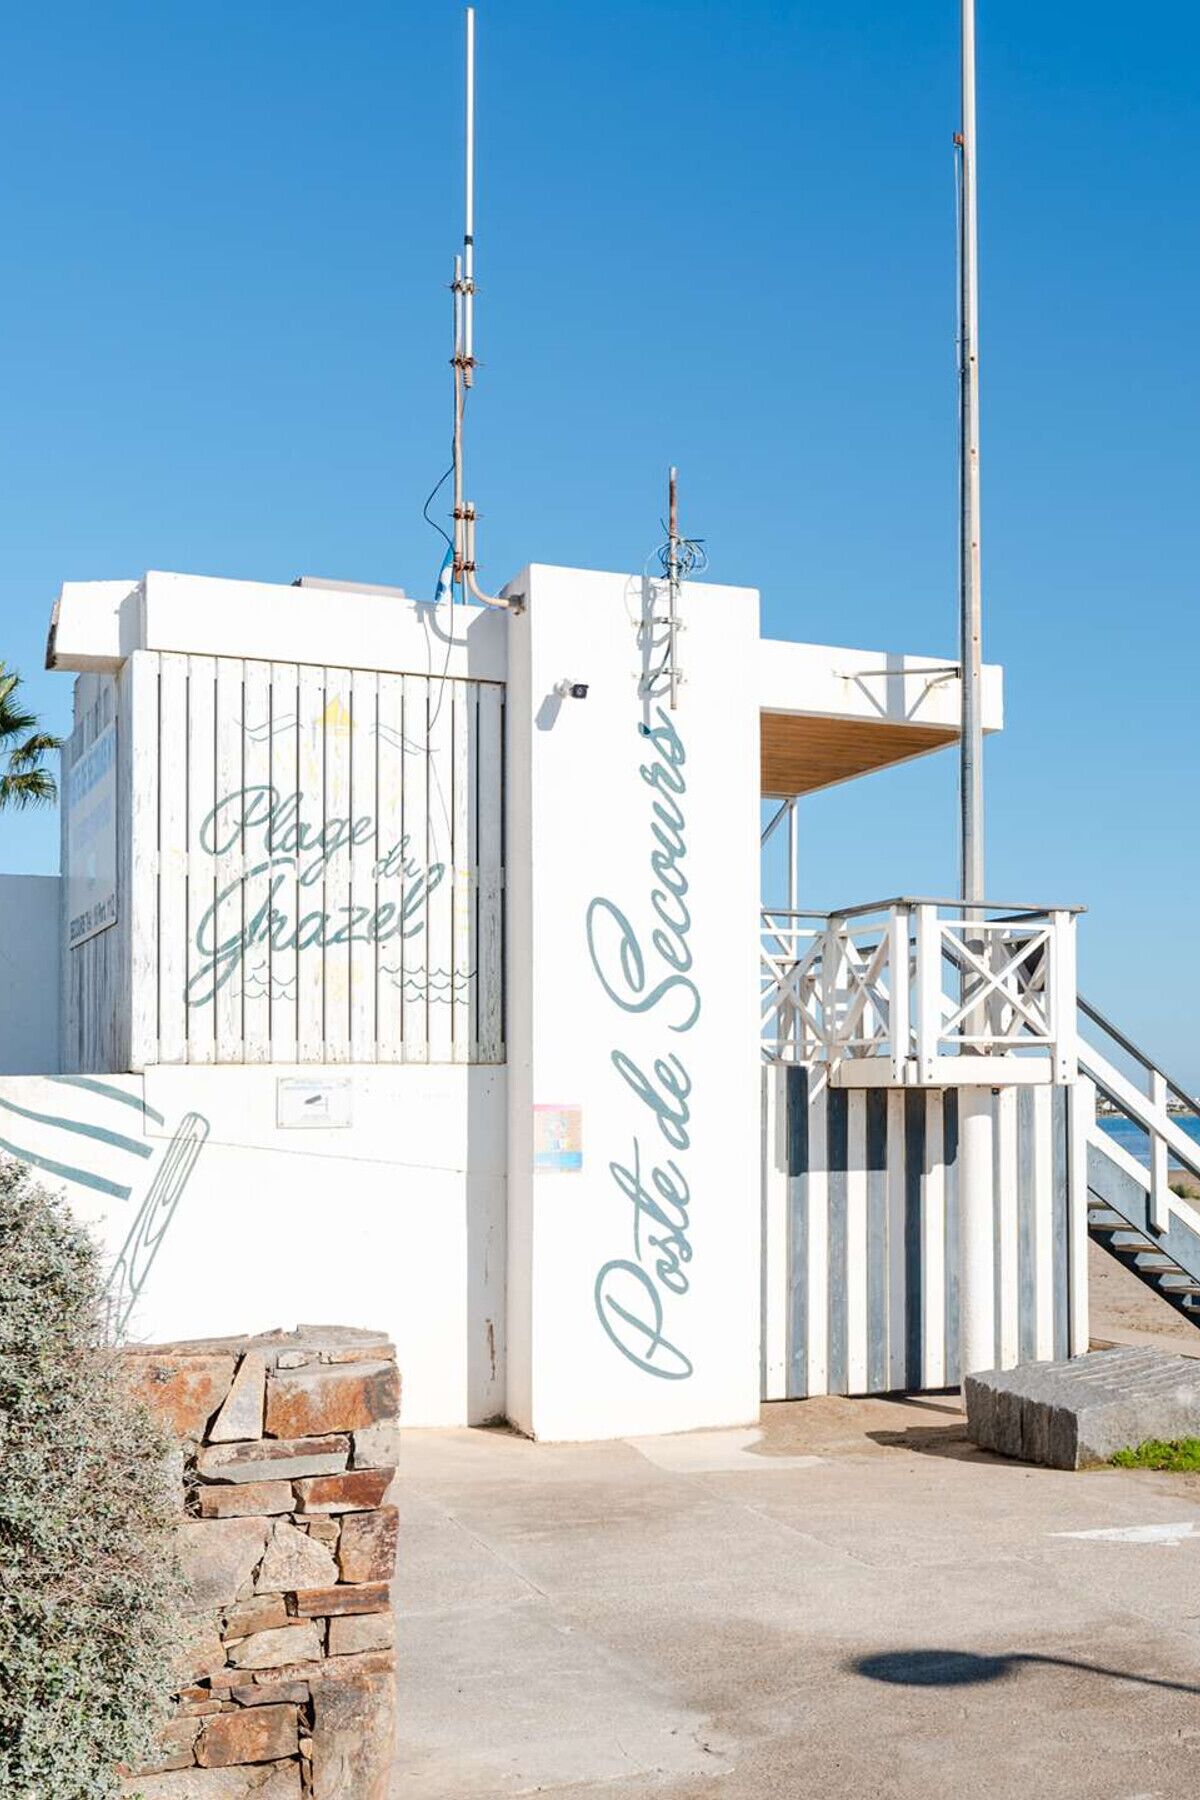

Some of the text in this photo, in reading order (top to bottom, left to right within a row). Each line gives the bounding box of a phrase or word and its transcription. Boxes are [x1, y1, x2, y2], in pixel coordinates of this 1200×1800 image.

[200, 785, 421, 886] Plage du
[184, 857, 446, 1007] Grazel
[586, 706, 701, 1381] Poste de Secours
